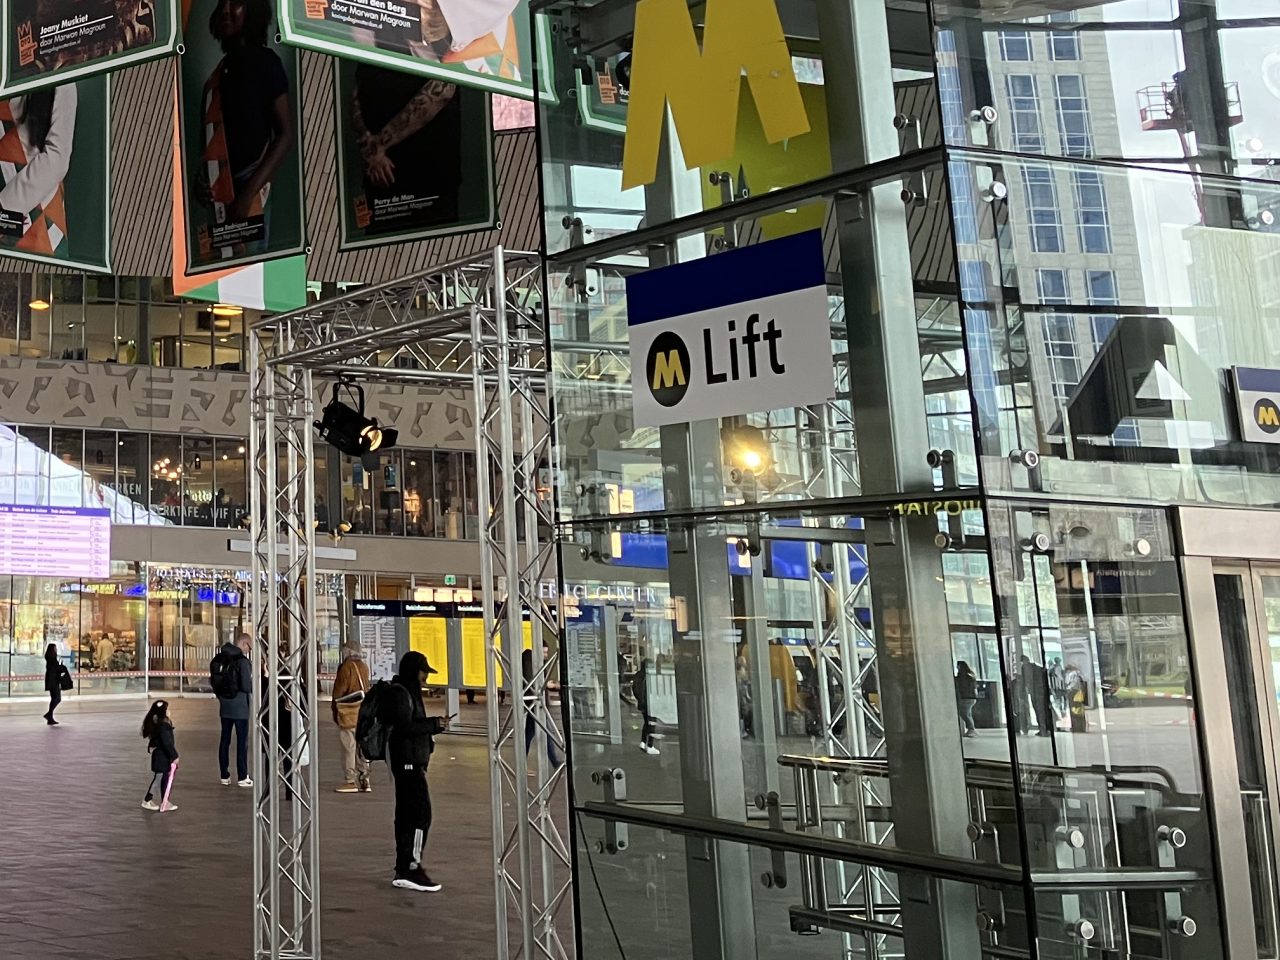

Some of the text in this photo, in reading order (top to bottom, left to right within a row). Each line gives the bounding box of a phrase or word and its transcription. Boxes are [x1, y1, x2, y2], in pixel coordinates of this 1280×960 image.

[331, 0, 348, 12] door
[349, 5, 379, 21] Marwan
[380, 14, 411, 28] Magroun
[387, 1, 407, 16] Berg
[40, 14, 89, 35] Joany Muskiet
[40, 23, 106, 47] door Marwan Magroun
[702, 313, 786, 385] Lift
